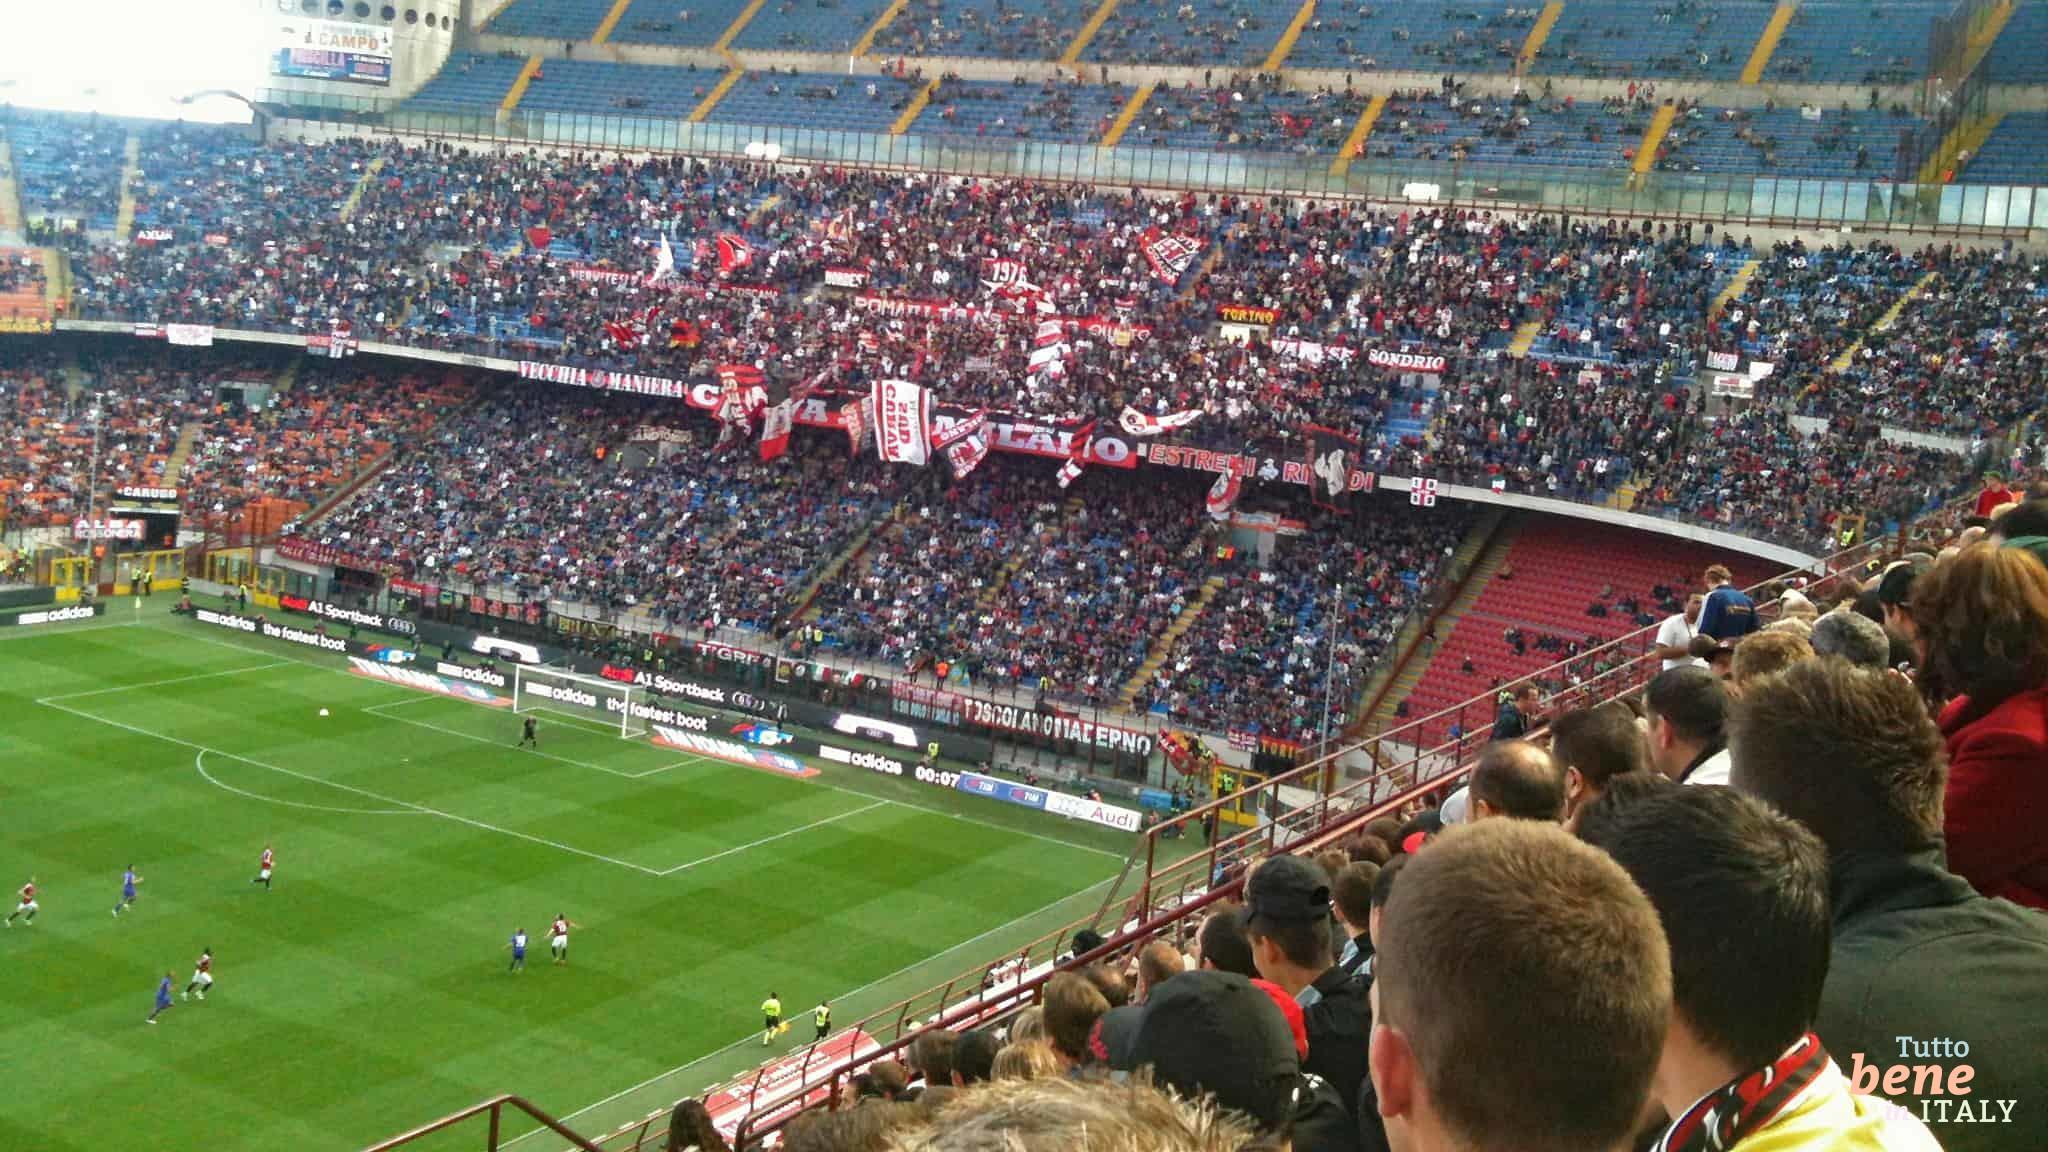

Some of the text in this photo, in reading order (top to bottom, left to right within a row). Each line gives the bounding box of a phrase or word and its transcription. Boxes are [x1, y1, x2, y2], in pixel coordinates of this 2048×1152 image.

[1221, 307, 1274, 323] TORINO
[1368, 348, 1445, 369] SONDRIO
[520, 361, 682, 398] VECCHIA MANIERA
[48, 606, 94, 621] adidas
[324, 604, 383, 627] Sportback
[220, 615, 346, 652] adidas the fastest boot
[463, 668, 505, 687] adidas
[633, 671, 652, 687] A1
[654, 675, 725, 702] Sportback
[552, 687, 597, 707] adidas
[630, 702, 675, 724] fastest
[676, 711, 708, 731] boot
[851, 752, 960, 788] adidas 00:07
[979, 781, 993, 792] TIM
[1024, 790, 1040, 802] TIM
[1090, 806, 1134, 829] Audi
